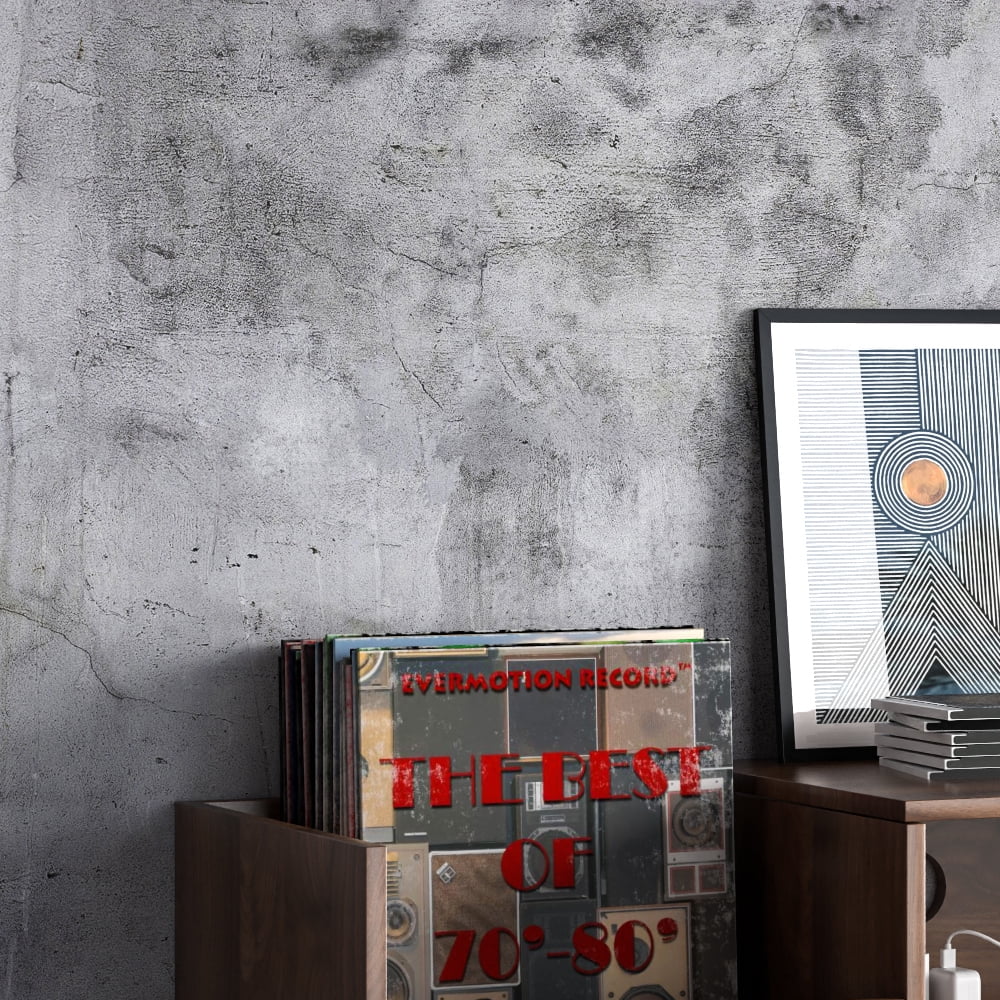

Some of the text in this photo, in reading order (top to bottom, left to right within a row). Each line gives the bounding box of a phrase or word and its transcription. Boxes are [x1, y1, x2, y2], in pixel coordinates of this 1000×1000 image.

[402, 669, 572, 695] EVERMOTION
[379, 746, 712, 809] THE BEST
[501, 837, 593, 892] OF
